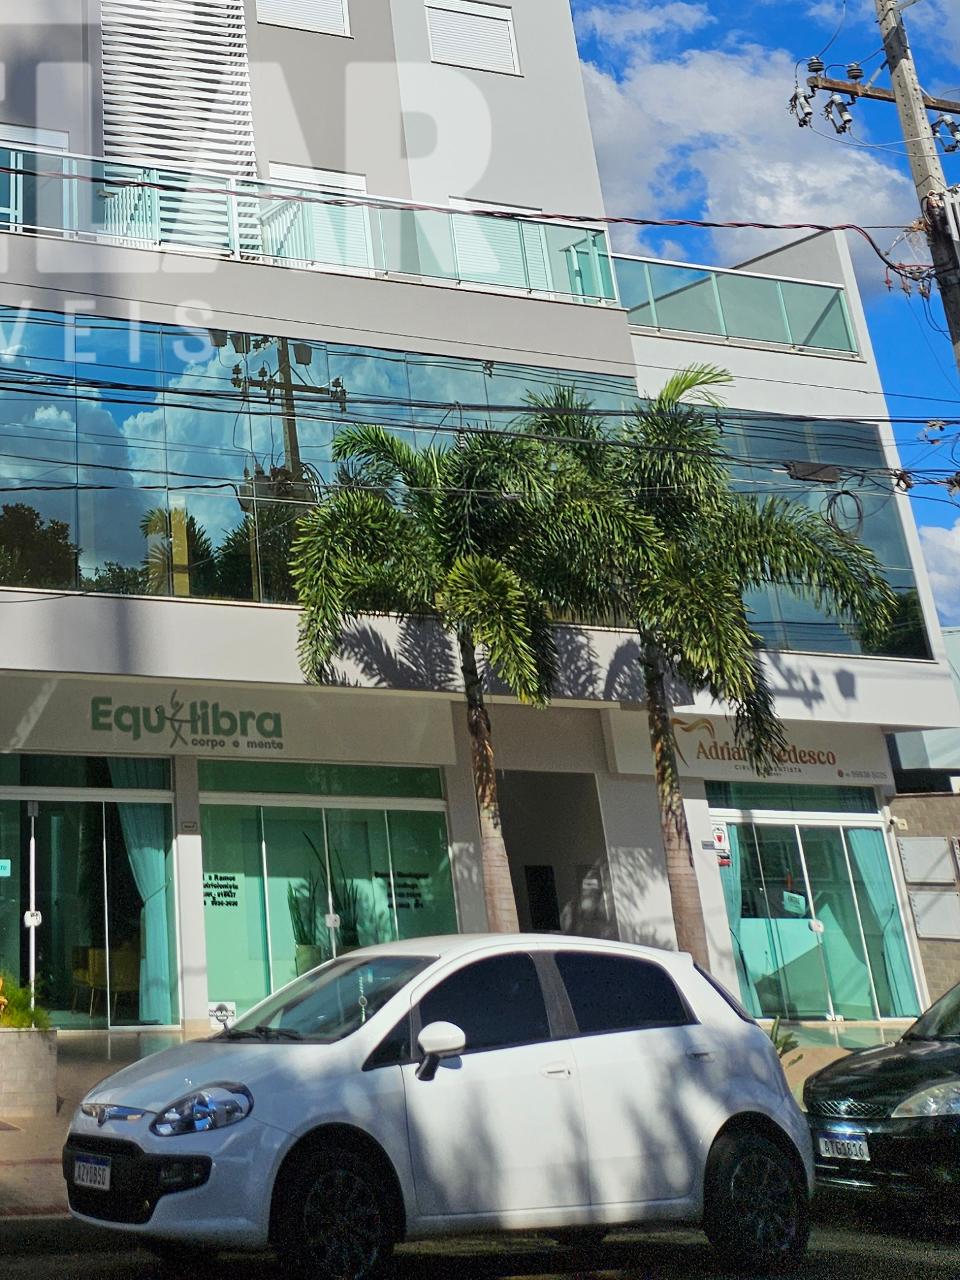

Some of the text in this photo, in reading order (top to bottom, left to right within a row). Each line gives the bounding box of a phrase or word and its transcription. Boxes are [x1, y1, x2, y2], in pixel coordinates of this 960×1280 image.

[191, 738, 284, 750] corpo e mente
